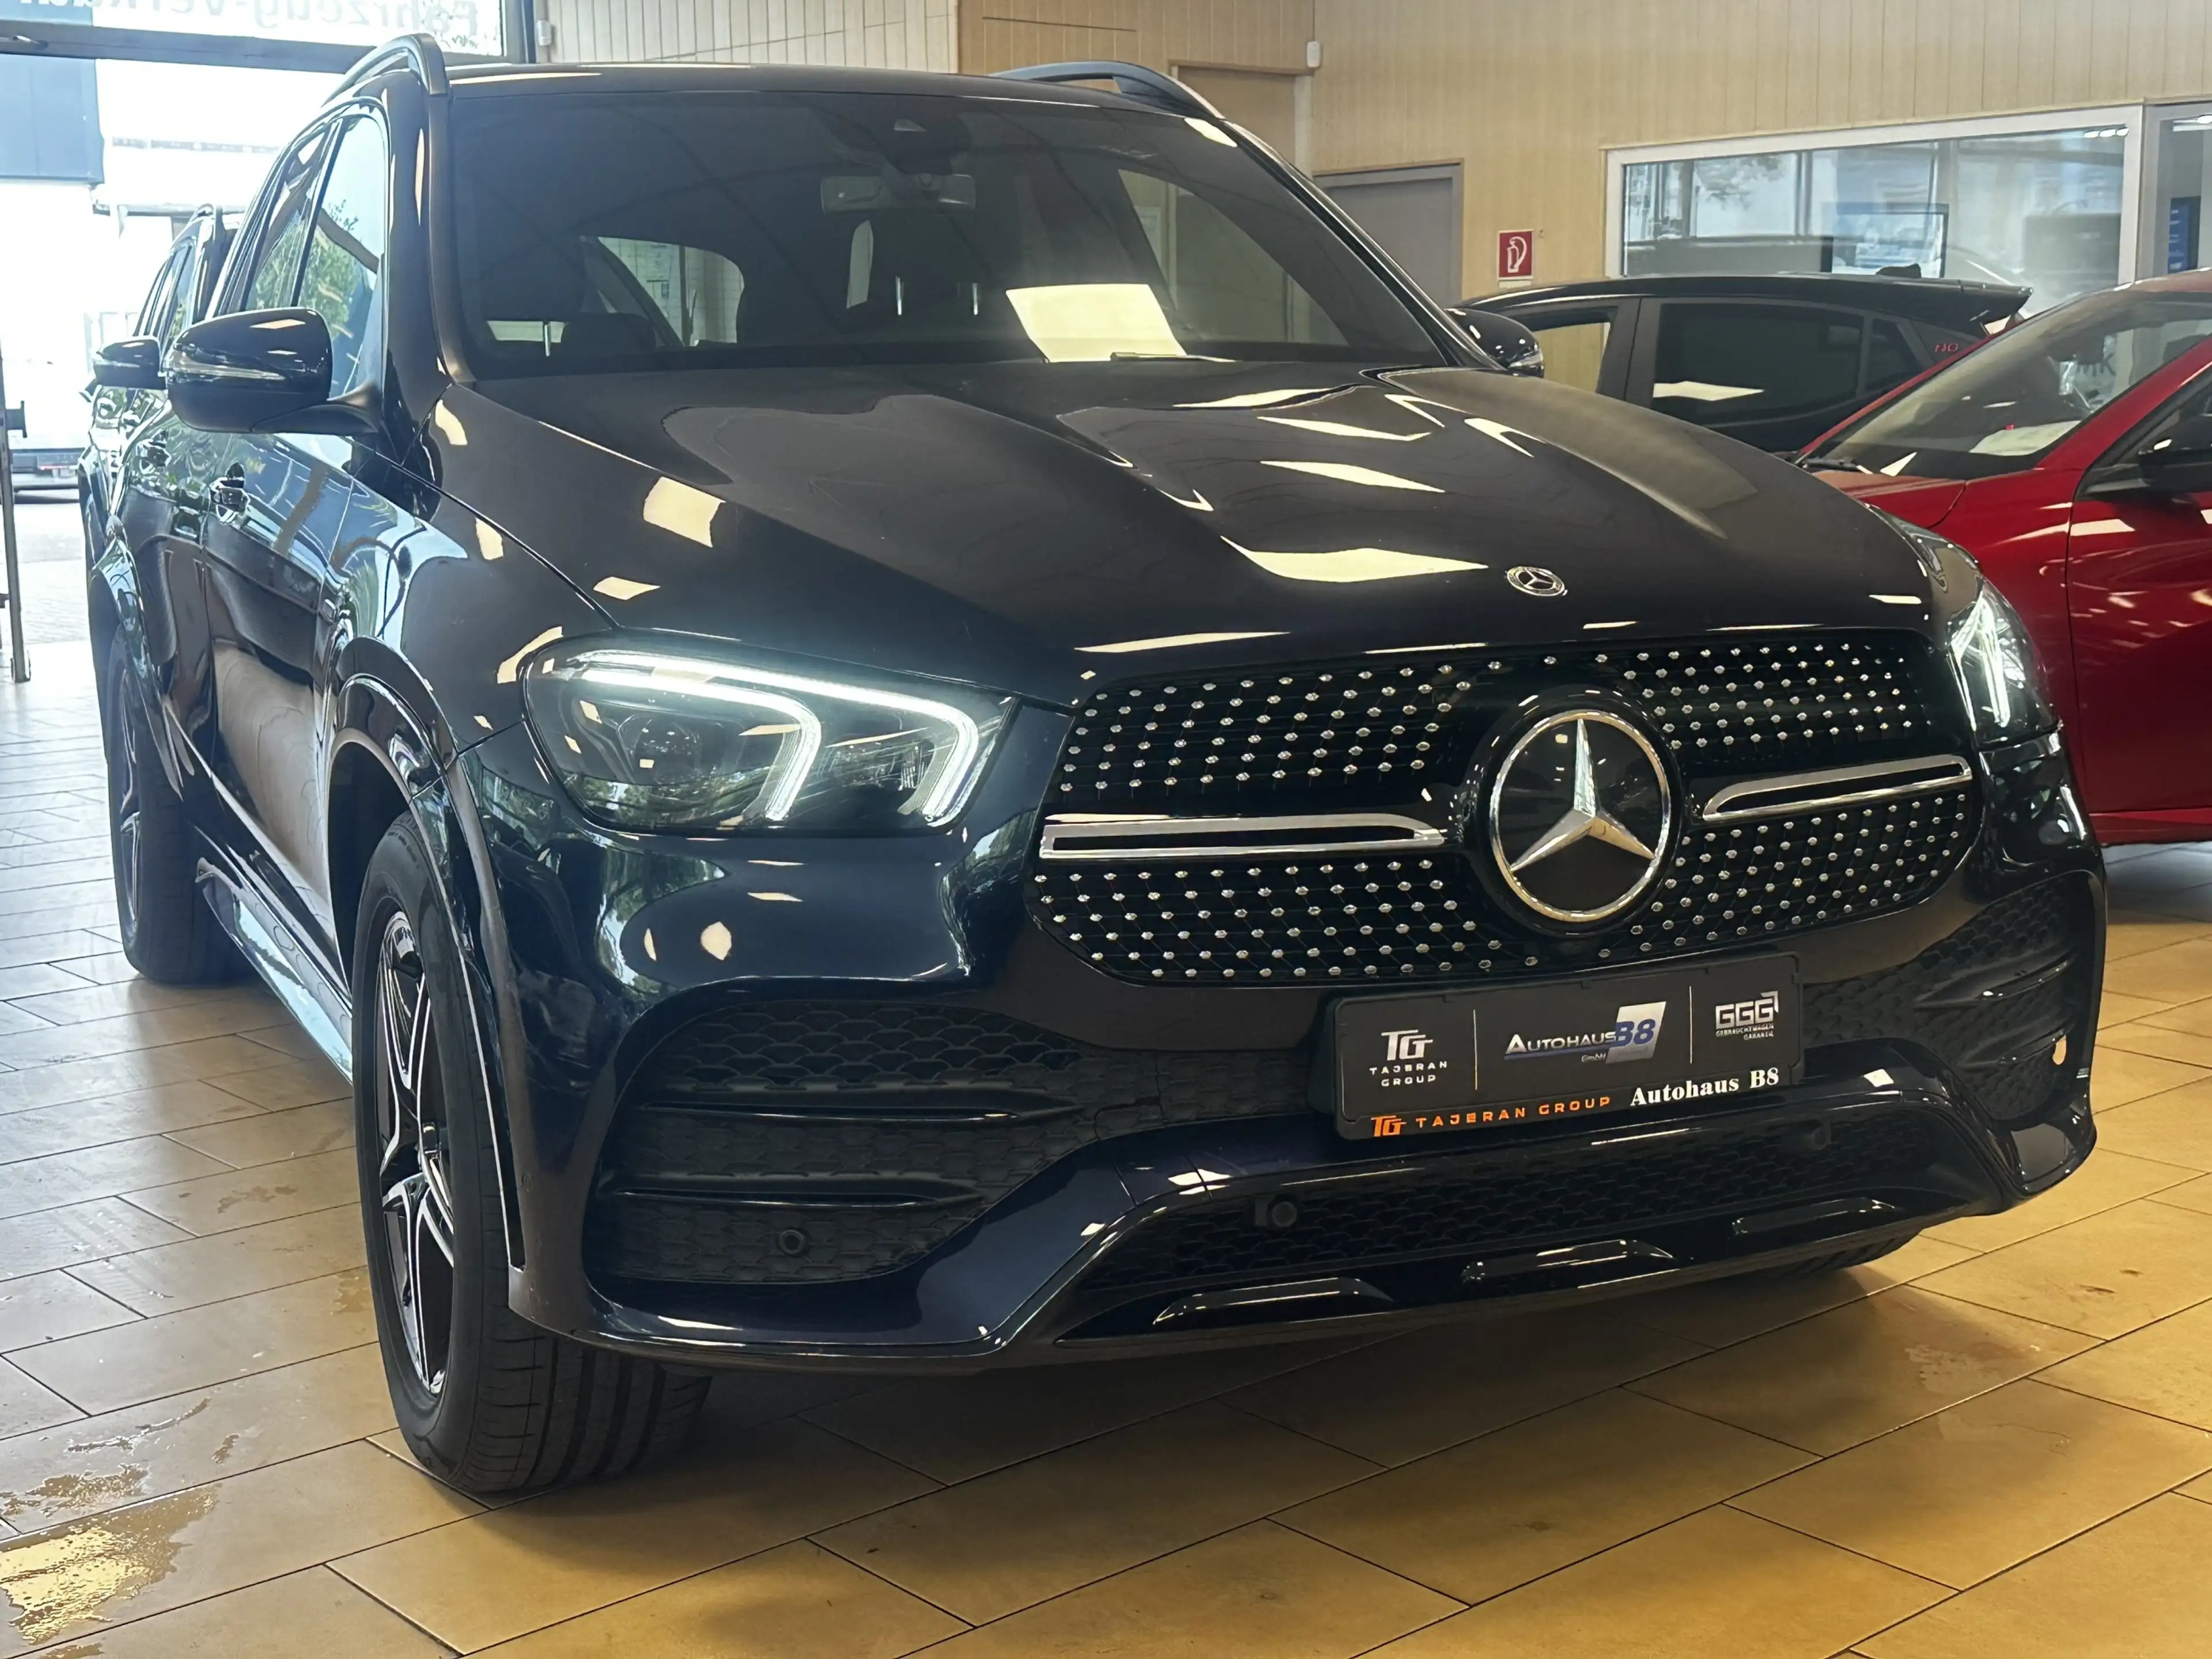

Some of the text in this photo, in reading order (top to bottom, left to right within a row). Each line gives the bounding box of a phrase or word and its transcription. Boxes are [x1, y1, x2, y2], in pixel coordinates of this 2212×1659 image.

[1715, 998, 1774, 1029] GGG
[1381, 1029, 1434, 1060] TG
[1611, 1018, 1656, 1048] B8
[1369, 1060, 1448, 1075] TAJERAN
[1381, 1074, 1436, 1087] GROUP
[1630, 1067, 1779, 1106] Autohaus B8
[1370, 1096, 1611, 1137] TG TAJERAN GROUP
